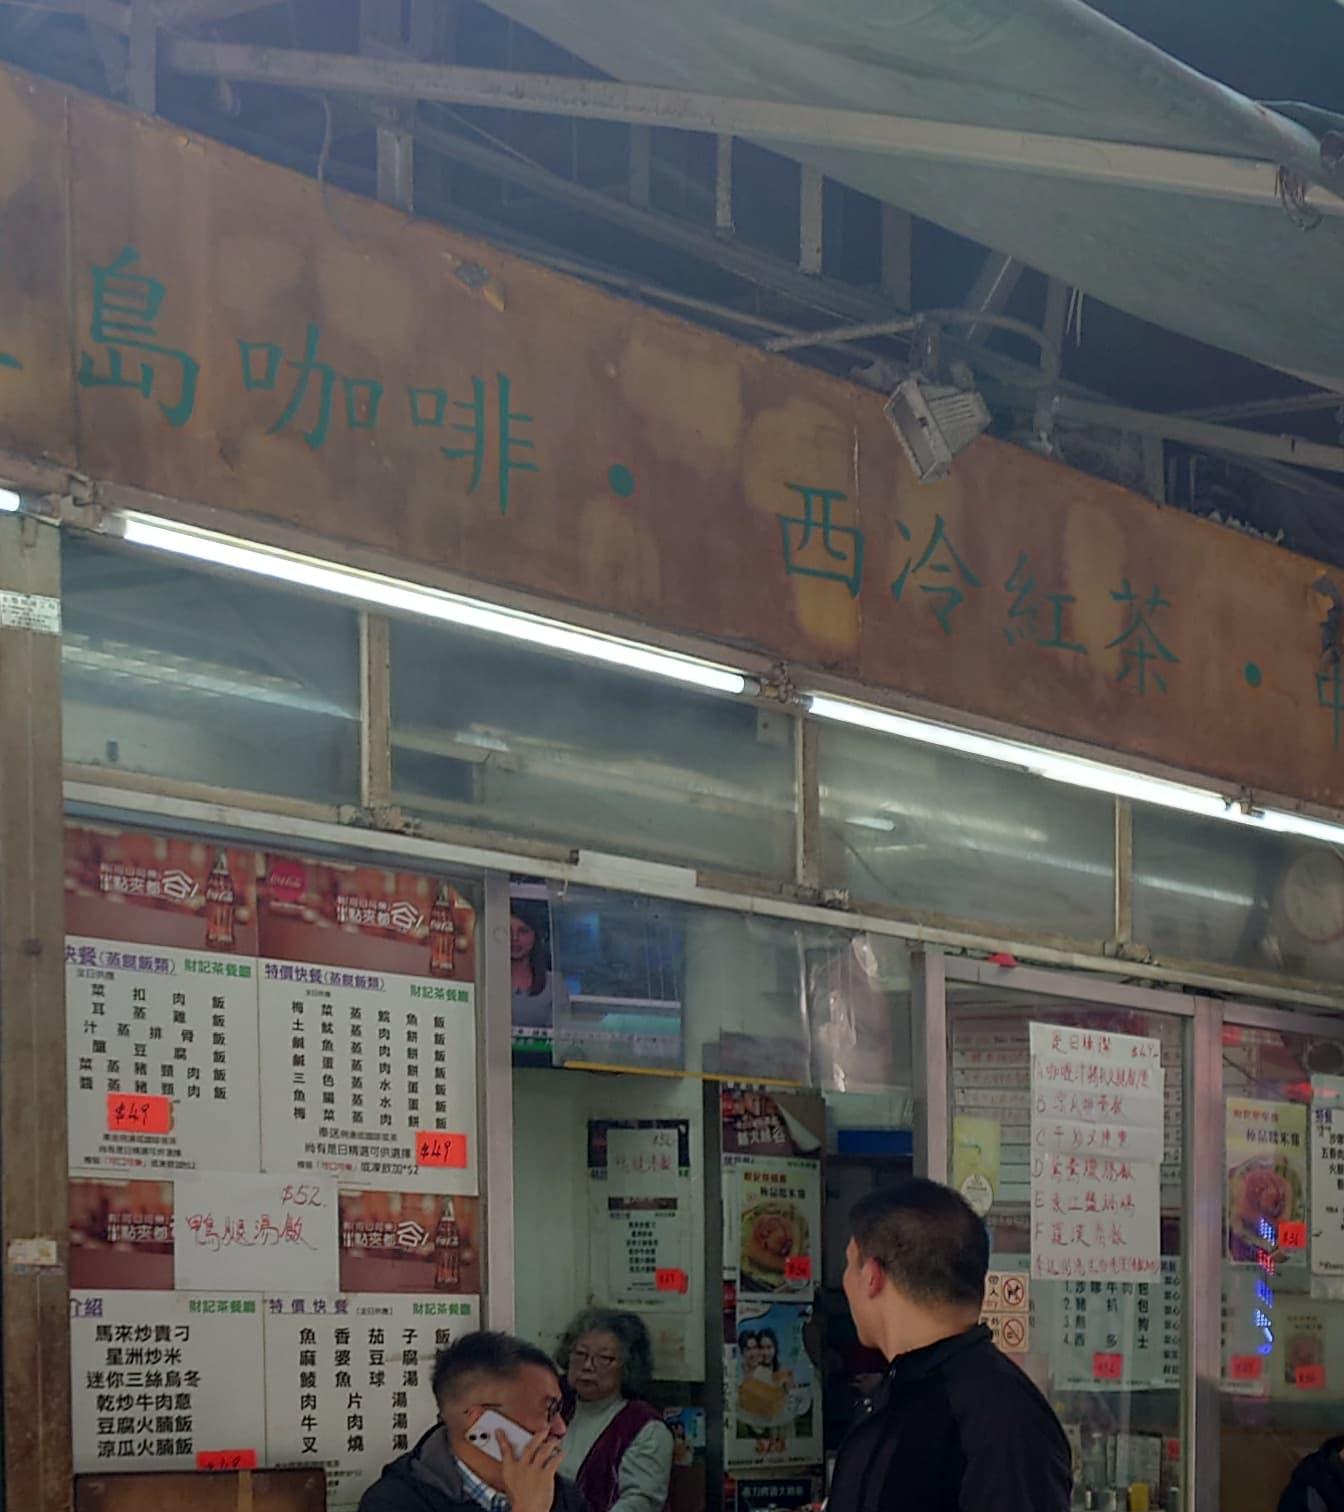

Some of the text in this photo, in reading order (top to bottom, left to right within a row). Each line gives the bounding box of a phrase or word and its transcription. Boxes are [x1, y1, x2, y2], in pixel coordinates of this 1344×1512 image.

[0, 246, 540, 515] 島咖啡
[780, 482, 1180, 697] 西冷紅茶
[189, 1299, 256, 1314] 財記茶餐廳
[269, 1298, 349, 1315] 特價快餐
[412, 1302, 472, 1316] 財記茶餐廳
[95, 1324, 190, 1343] 馬來炒貴刁
[299, 1327, 451, 1345] 魚香茄子飯
[105, 1347, 182, 1366] 星洲炒米
[299, 1349, 446, 1366] 麻婆豆腐
[96, 1393, 192, 1412] 乾炒牛肉意
[300, 1391, 408, 1410] 肉片湯
[97, 1416, 193, 1436] 豆腐火腩飯
[301, 1413, 408, 1432] 牛肉湯
[97, 1437, 193, 1458] 涼瓜火腩飯
[301, 1435, 409, 1454] 叉燒湯
